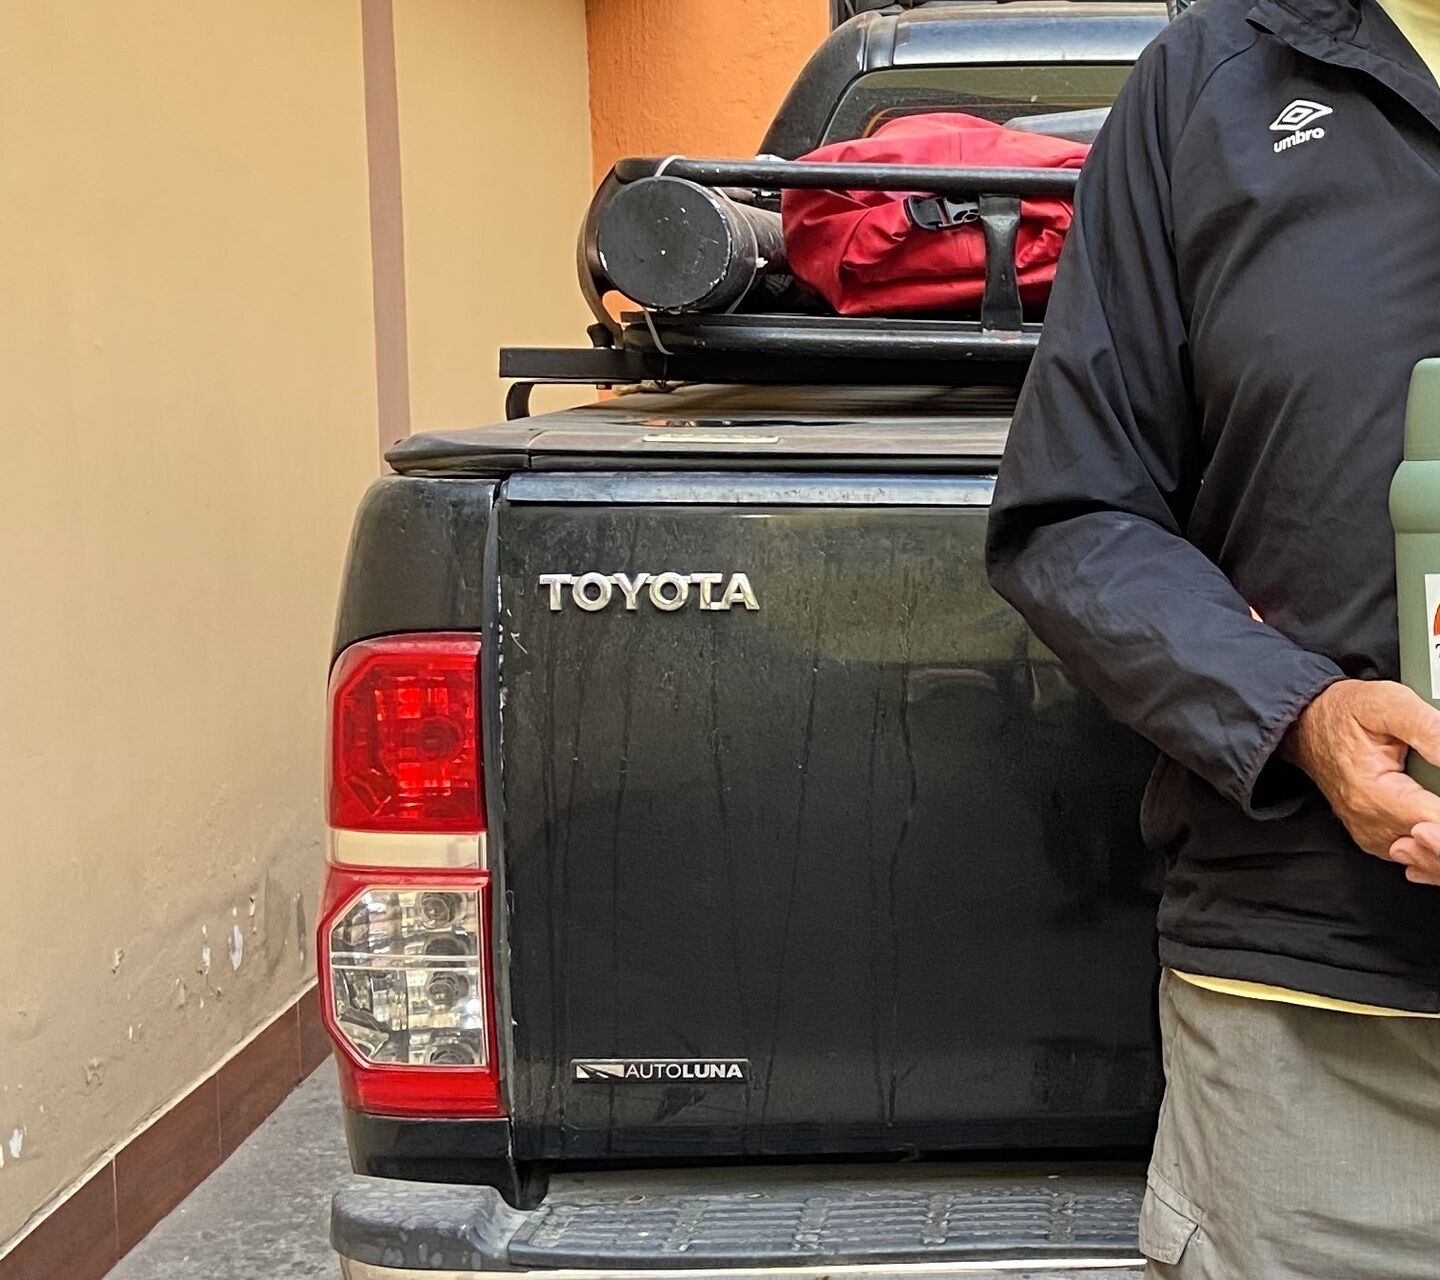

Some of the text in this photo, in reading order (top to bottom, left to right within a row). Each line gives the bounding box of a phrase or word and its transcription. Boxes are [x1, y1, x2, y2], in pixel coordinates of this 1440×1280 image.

[1273, 127, 1325, 153] umbro
[539, 571, 760, 612] TOYOTA
[624, 1063, 744, 1079] AUTOLUNA
